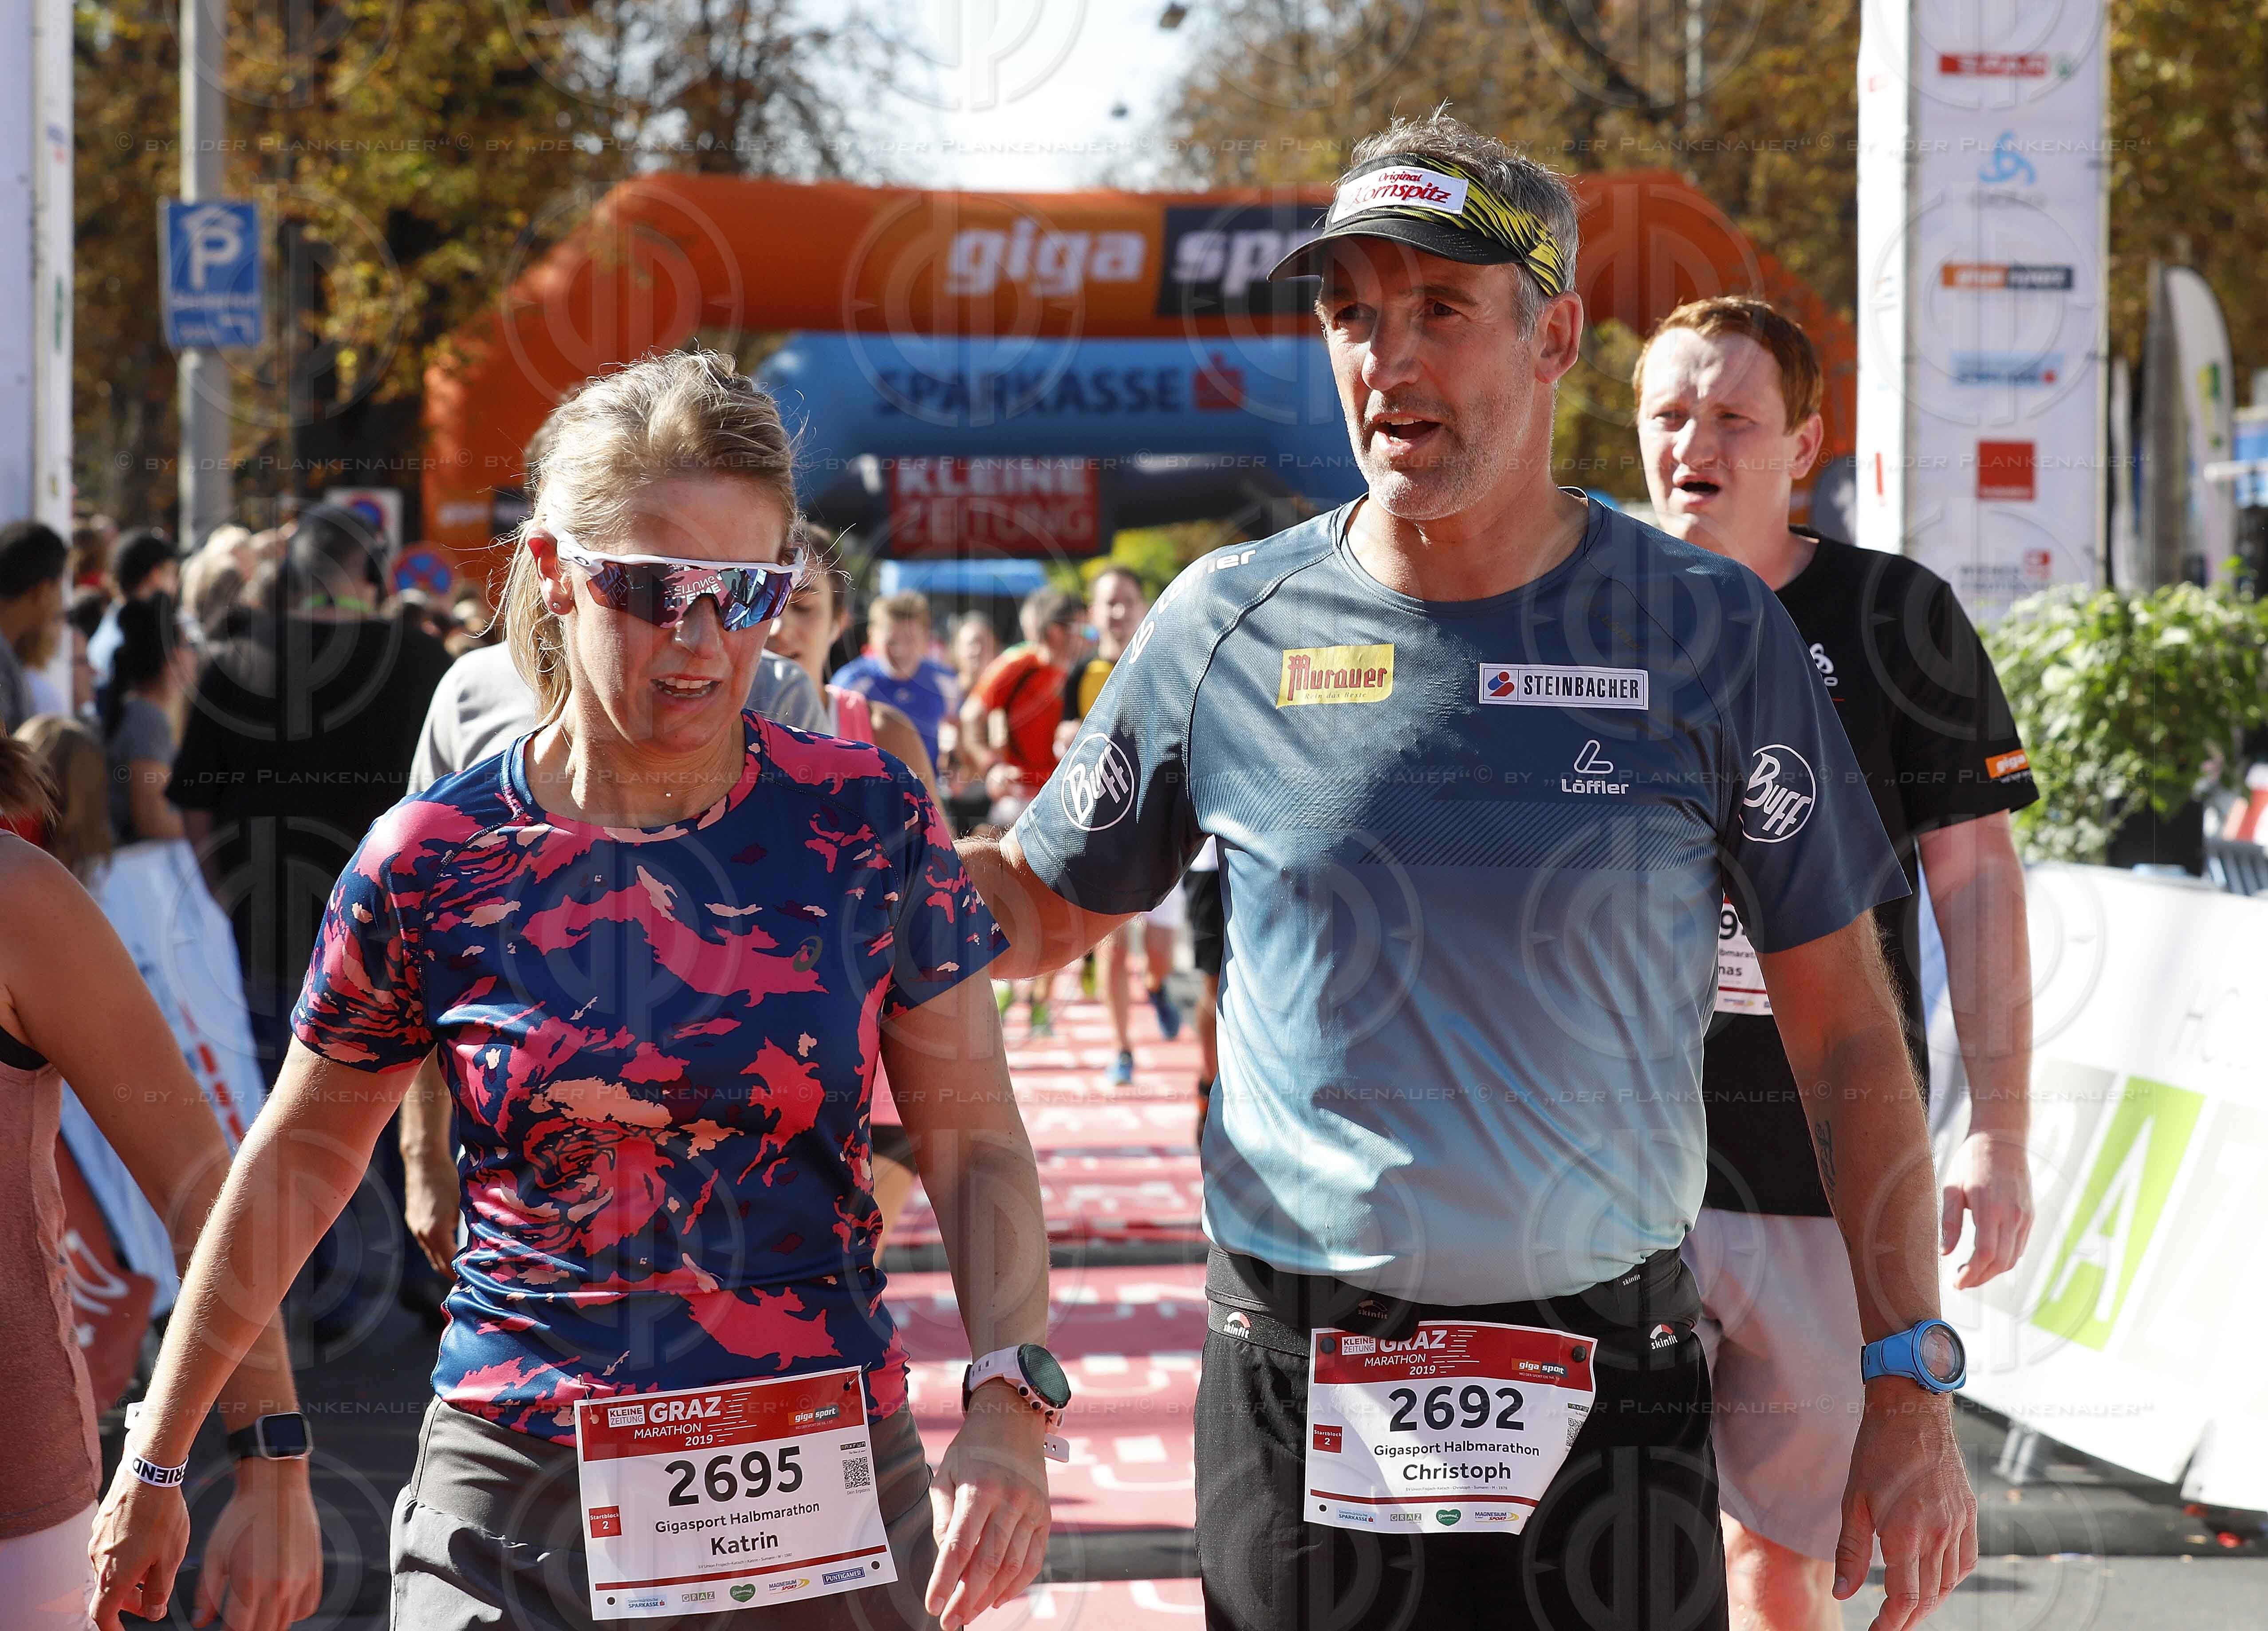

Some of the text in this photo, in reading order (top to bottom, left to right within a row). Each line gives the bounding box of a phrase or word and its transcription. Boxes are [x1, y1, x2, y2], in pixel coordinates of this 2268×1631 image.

[1378, 171, 1423, 183] Original
[1345, 182, 1452, 210] Kornspitz
[945, 217, 1146, 297] giga
[877, 368, 1182, 415] SPARKASSE
[895, 461, 1087, 495] KLEINE
[892, 502, 1096, 544] ZEITUNG
[1288, 654, 1387, 701] Murauer
[1523, 674, 1639, 700] STEINBACHER
[1562, 778, 1629, 794] Löffler
[1622, 1274, 1641, 1286] skinfit
[1358, 1310, 1388, 1320] skinfit
[1223, 1324, 1250, 1339] skinfit
[1343, 1337, 1375, 1346] KLEINE
[1379, 1330, 1448, 1352] GRAZ
[1651, 1335, 1678, 1350] skinfit
[1343, 1344, 1375, 1355] ZEITUNG
[1364, 1353, 1426, 1367] MARATHON
[1409, 1365, 1436, 1376] 2019
[1519, 1361, 1565, 1375] giga sport
[610, 1407, 643, 1418] KLEINE
[649, 1396, 722, 1423] GRAZ
[795, 1407, 836, 1423] giga sport
[1389, 1384, 1525, 1433] 2692
[610, 1415, 645, 1426] ZEITUNG
[633, 1422, 702, 1439] MARATHON
[1314, 1429, 1343, 1438] Startblock
[685, 1434, 714, 1446] 2019
[1324, 1437, 1331, 1446] 2
[1374, 1440, 1540, 1458] Gigasport Halbmarathon
[664, 1446, 803, 1507] 2695
[1402, 1462, 1512, 1483] Christoph
[590, 1512, 619, 1521] Startblock
[655, 1501, 820, 1534] Gigasport Halbmarathon
[602, 1521, 610, 1530] 2
[711, 1532, 779, 1556] Katrin
[825, 1569, 862, 1583] PUNTIGAMER
[768, 1579, 797, 1589] MAGNESIUM
[682, 1591, 715, 1602] GRAZ
